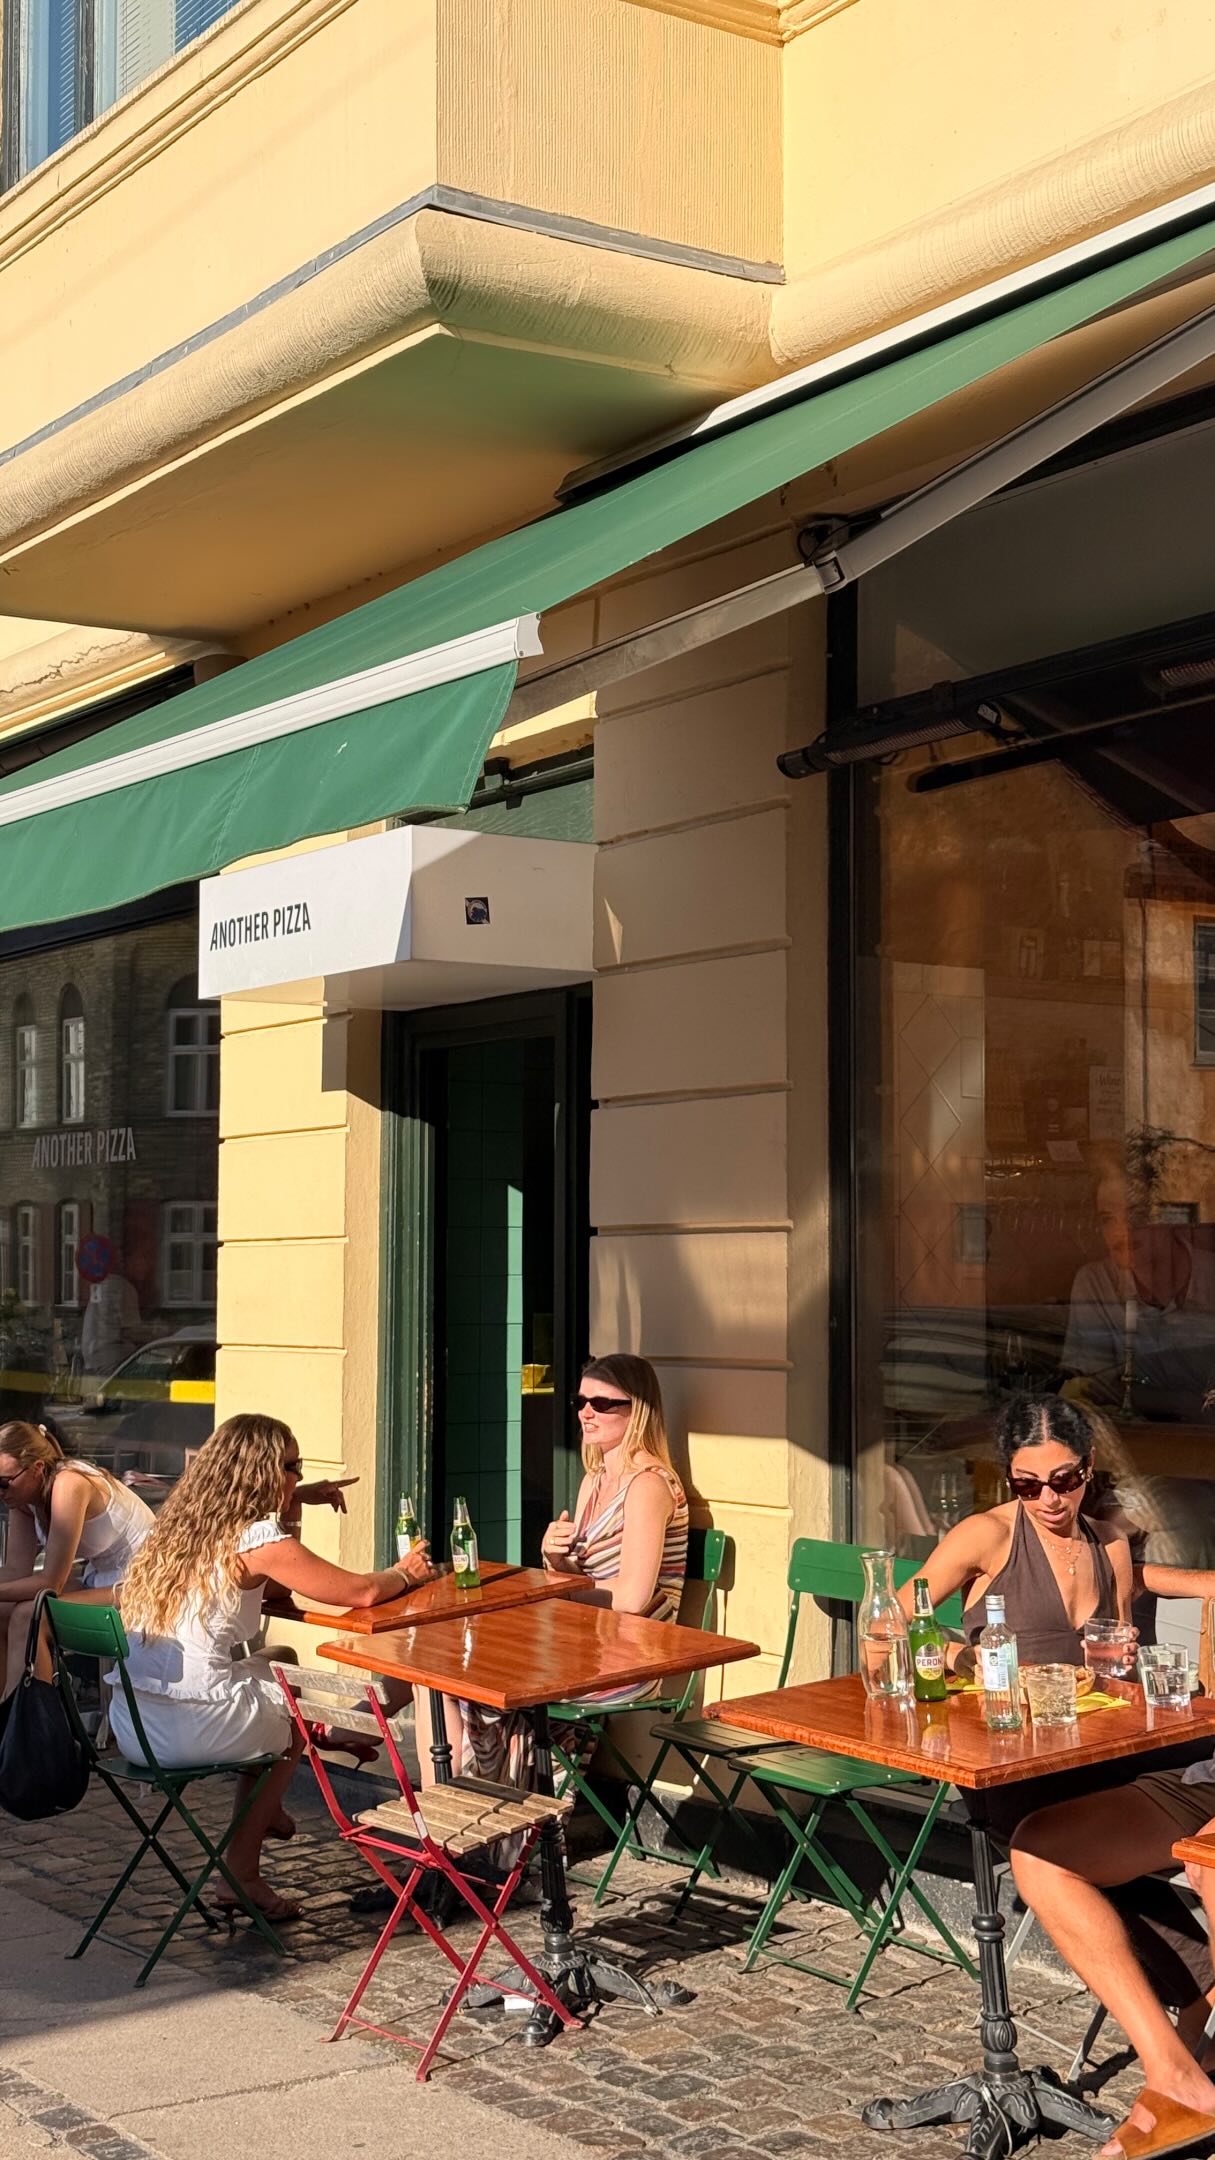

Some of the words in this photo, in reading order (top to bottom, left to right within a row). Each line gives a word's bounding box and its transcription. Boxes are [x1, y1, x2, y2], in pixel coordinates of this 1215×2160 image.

[209, 911, 269, 951] ANOTHER
[273, 901, 311, 937] PIZZA
[32, 1132, 92, 1168] ANOTHER
[96, 1127, 136, 1162] PIZZA
[916, 1657, 944, 1667] PERON
